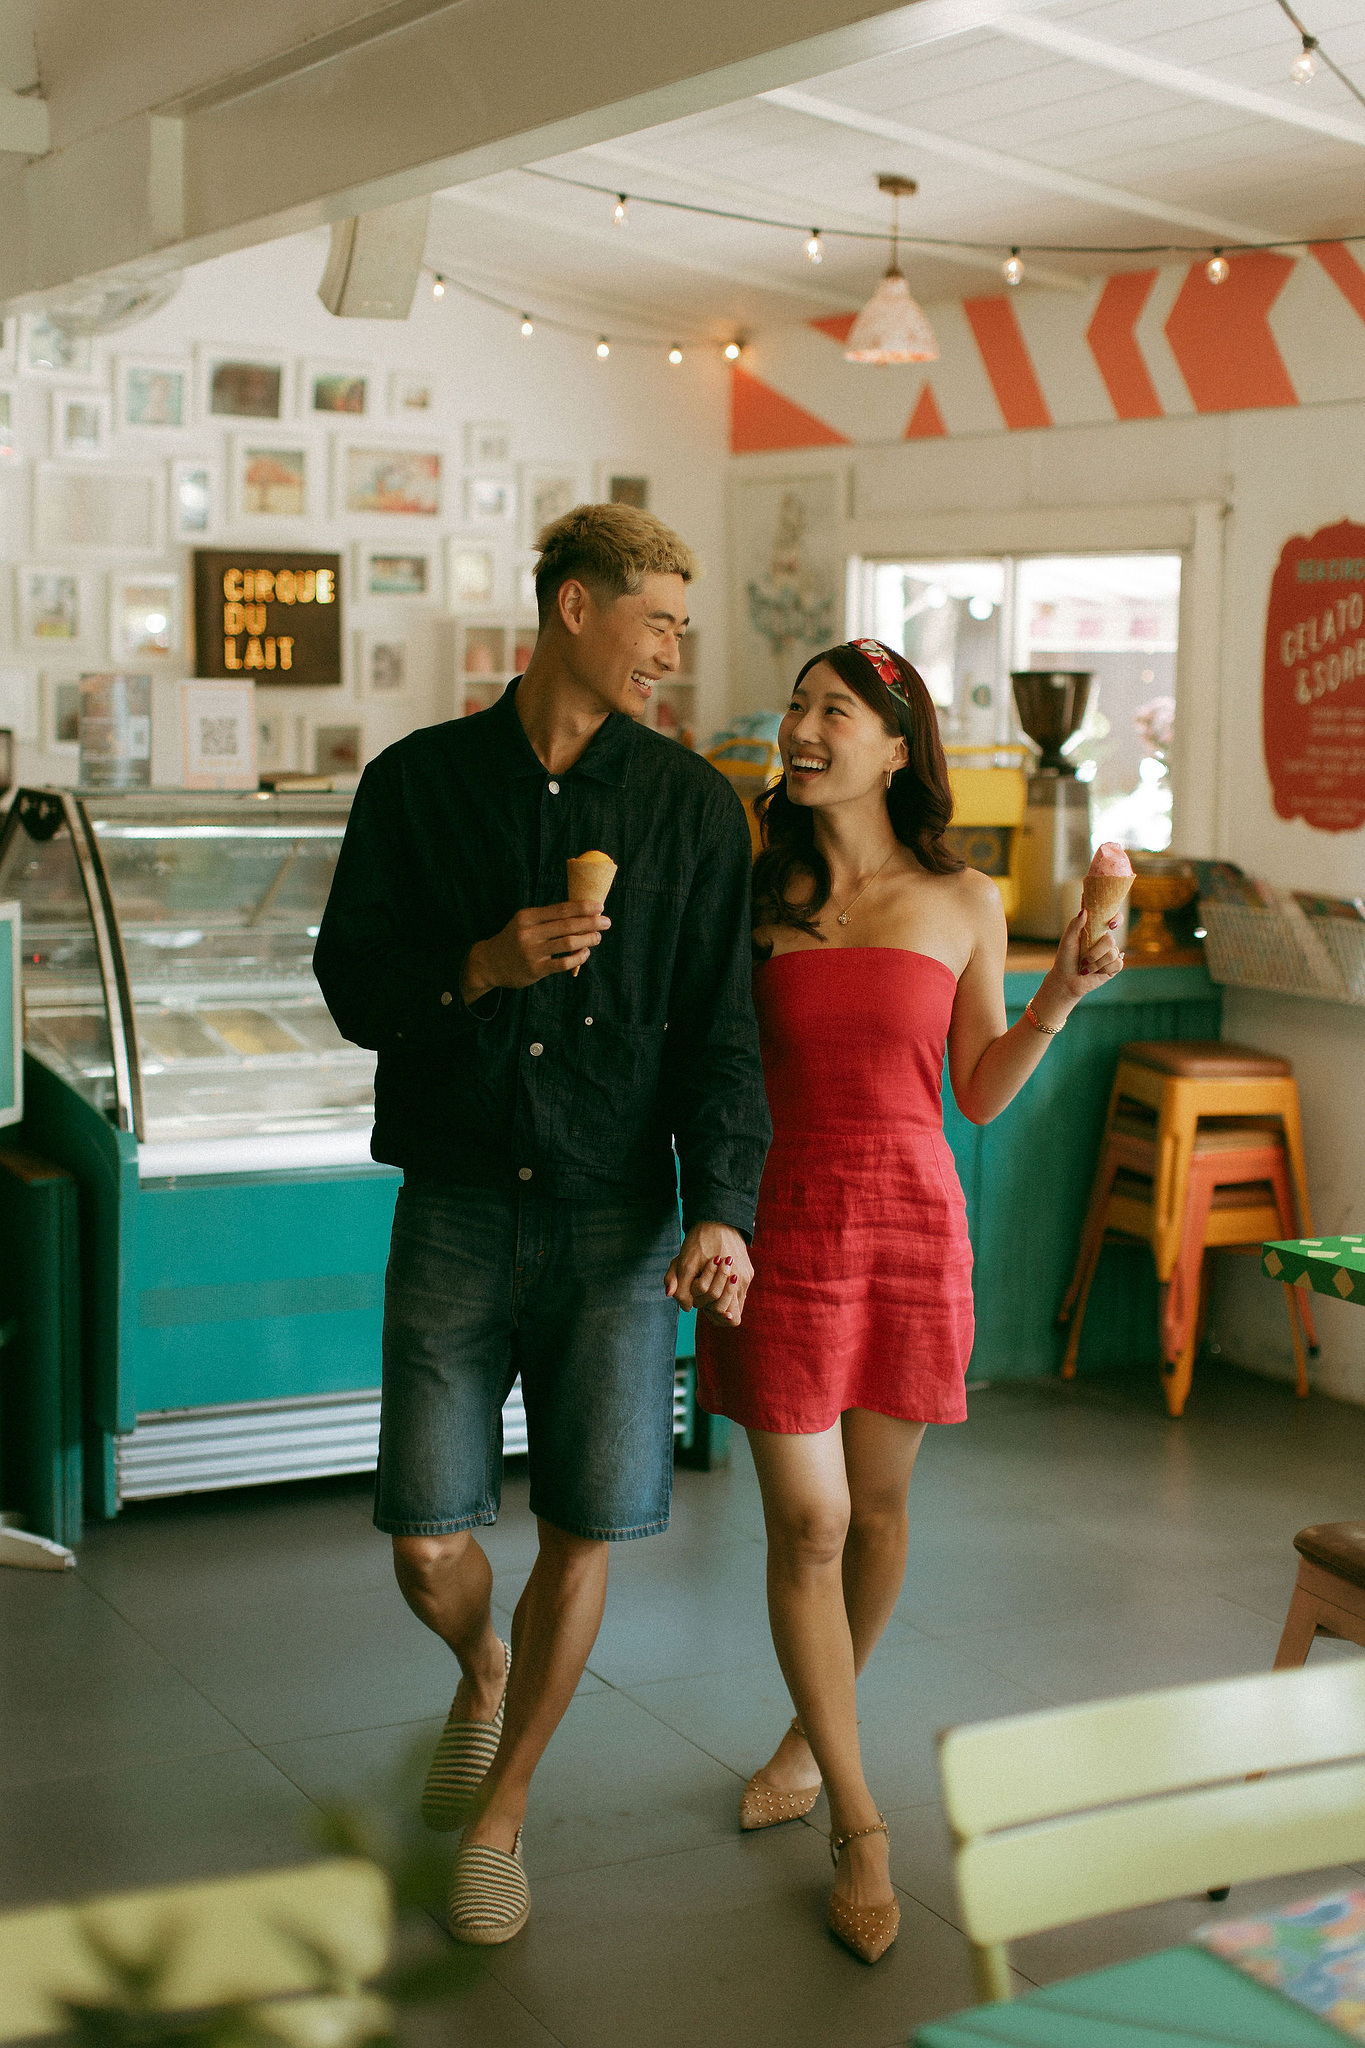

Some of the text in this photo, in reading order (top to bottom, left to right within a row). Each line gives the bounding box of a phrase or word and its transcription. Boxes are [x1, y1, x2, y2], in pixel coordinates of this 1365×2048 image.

[224, 568, 335, 605] CIRQUE
[224, 603, 266, 636] DU
[1281, 593, 1363, 667] GELATO
[224, 636, 294, 670] LAIT
